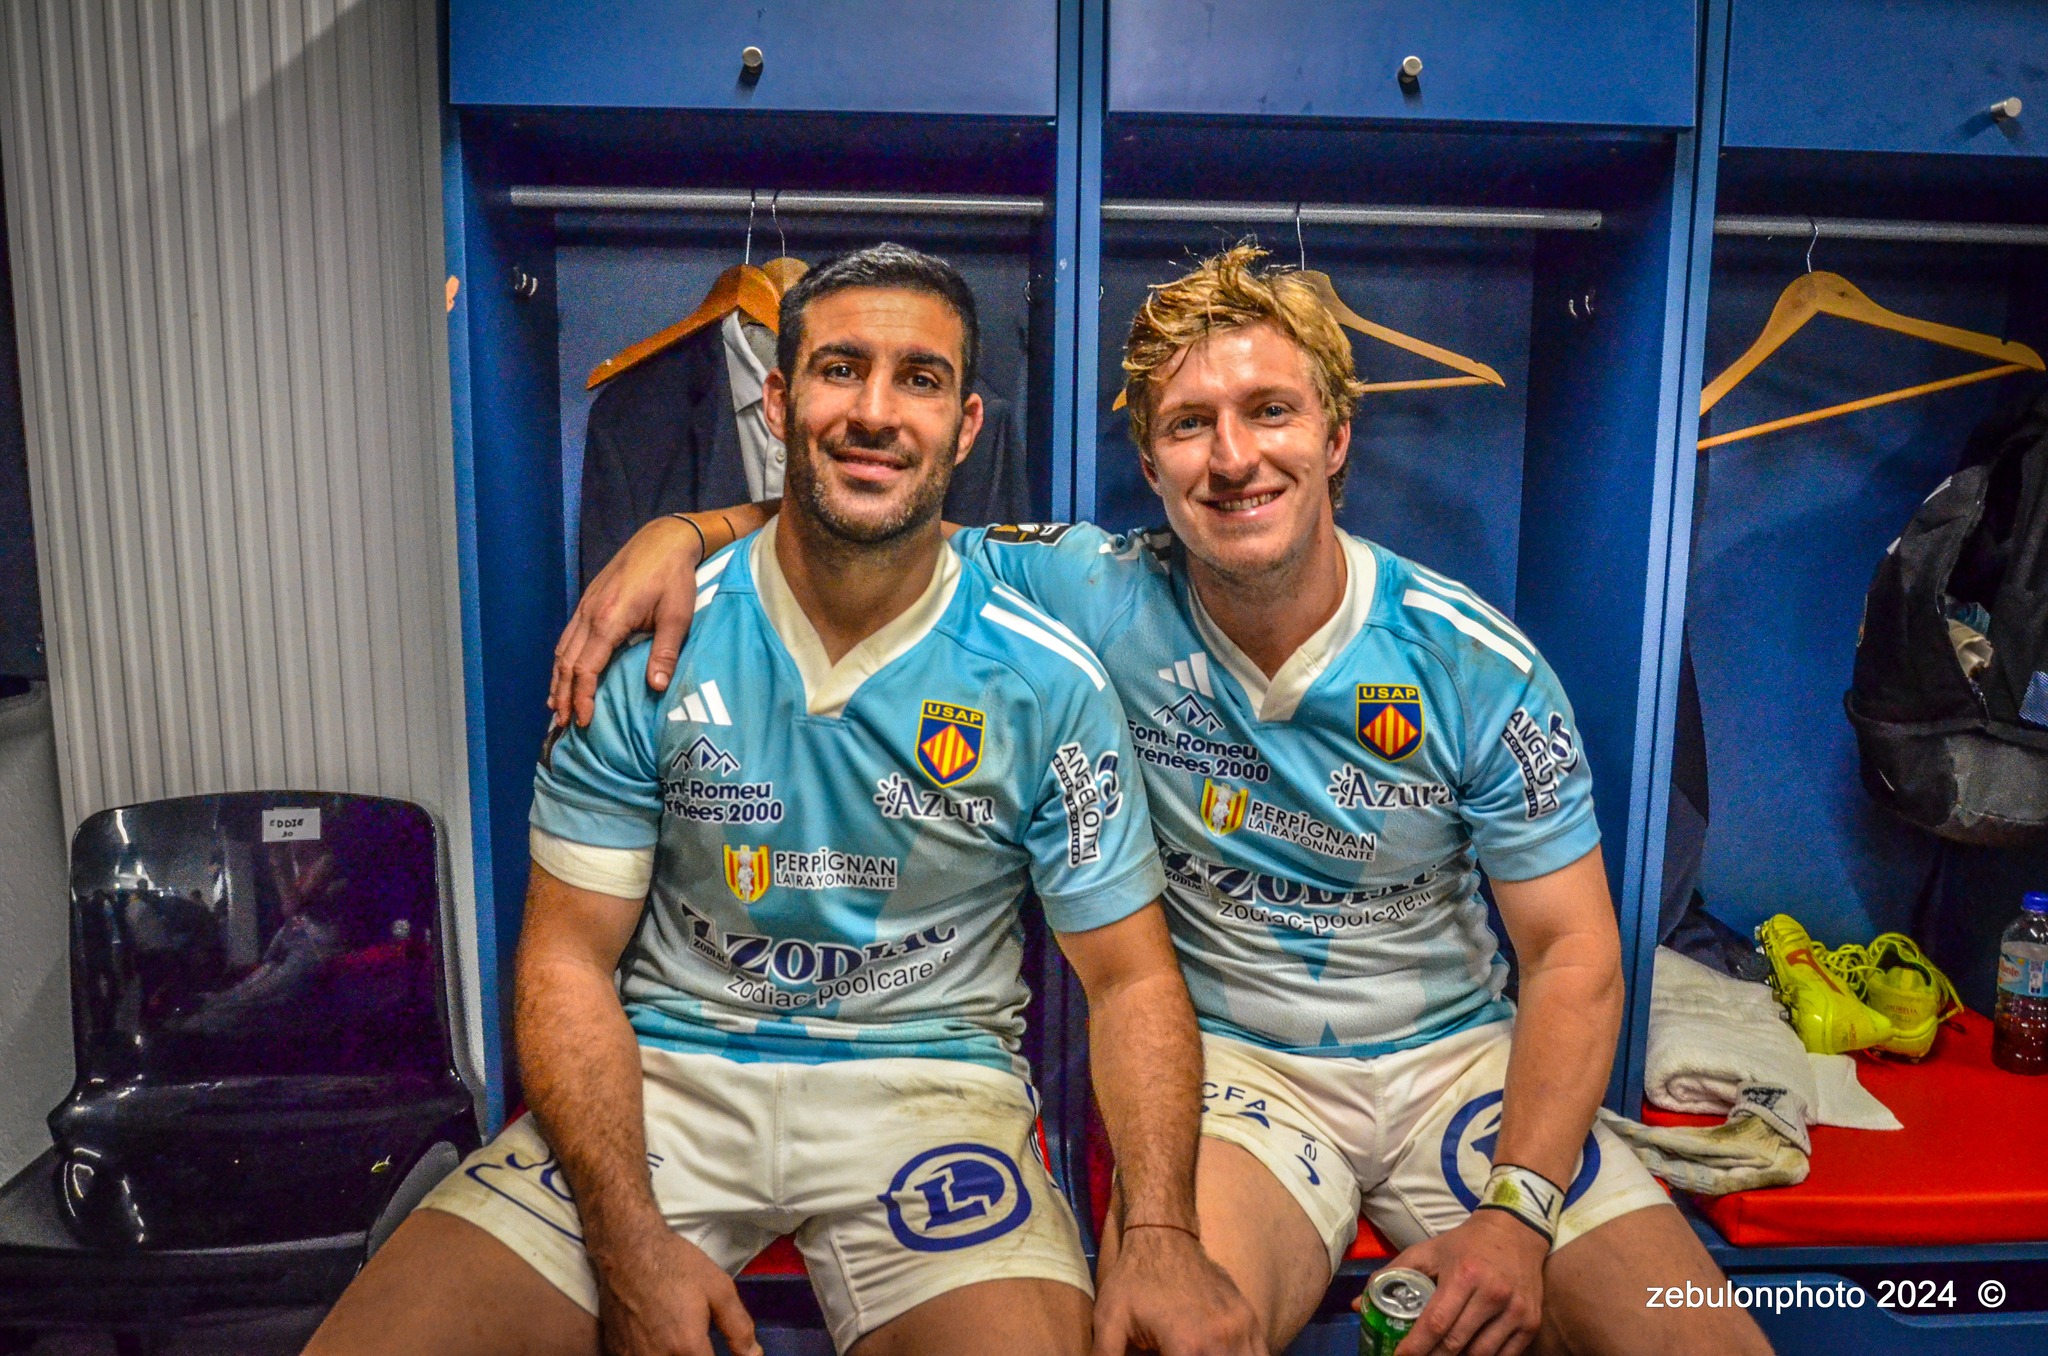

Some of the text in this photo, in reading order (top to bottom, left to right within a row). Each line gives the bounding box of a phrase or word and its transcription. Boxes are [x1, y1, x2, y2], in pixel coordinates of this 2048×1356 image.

[1362, 687, 1417, 699] USAP
[927, 703, 981, 722] USAP
[1133, 745, 1269, 782] rénées 2000
[660, 777, 771, 800] ont-Romeu
[893, 781, 994, 824] Azura
[1061, 745, 1099, 861] ANGELOTTI
[1346, 771, 1454, 808] Azura
[728, 801, 782, 821] 2000
[1251, 800, 1375, 851] PERPIGNAN
[1248, 817, 1375, 861] LA RAYONNANTE
[775, 848, 895, 876] PERPIGNAN
[776, 872, 896, 888] LA RAYONNANTE
